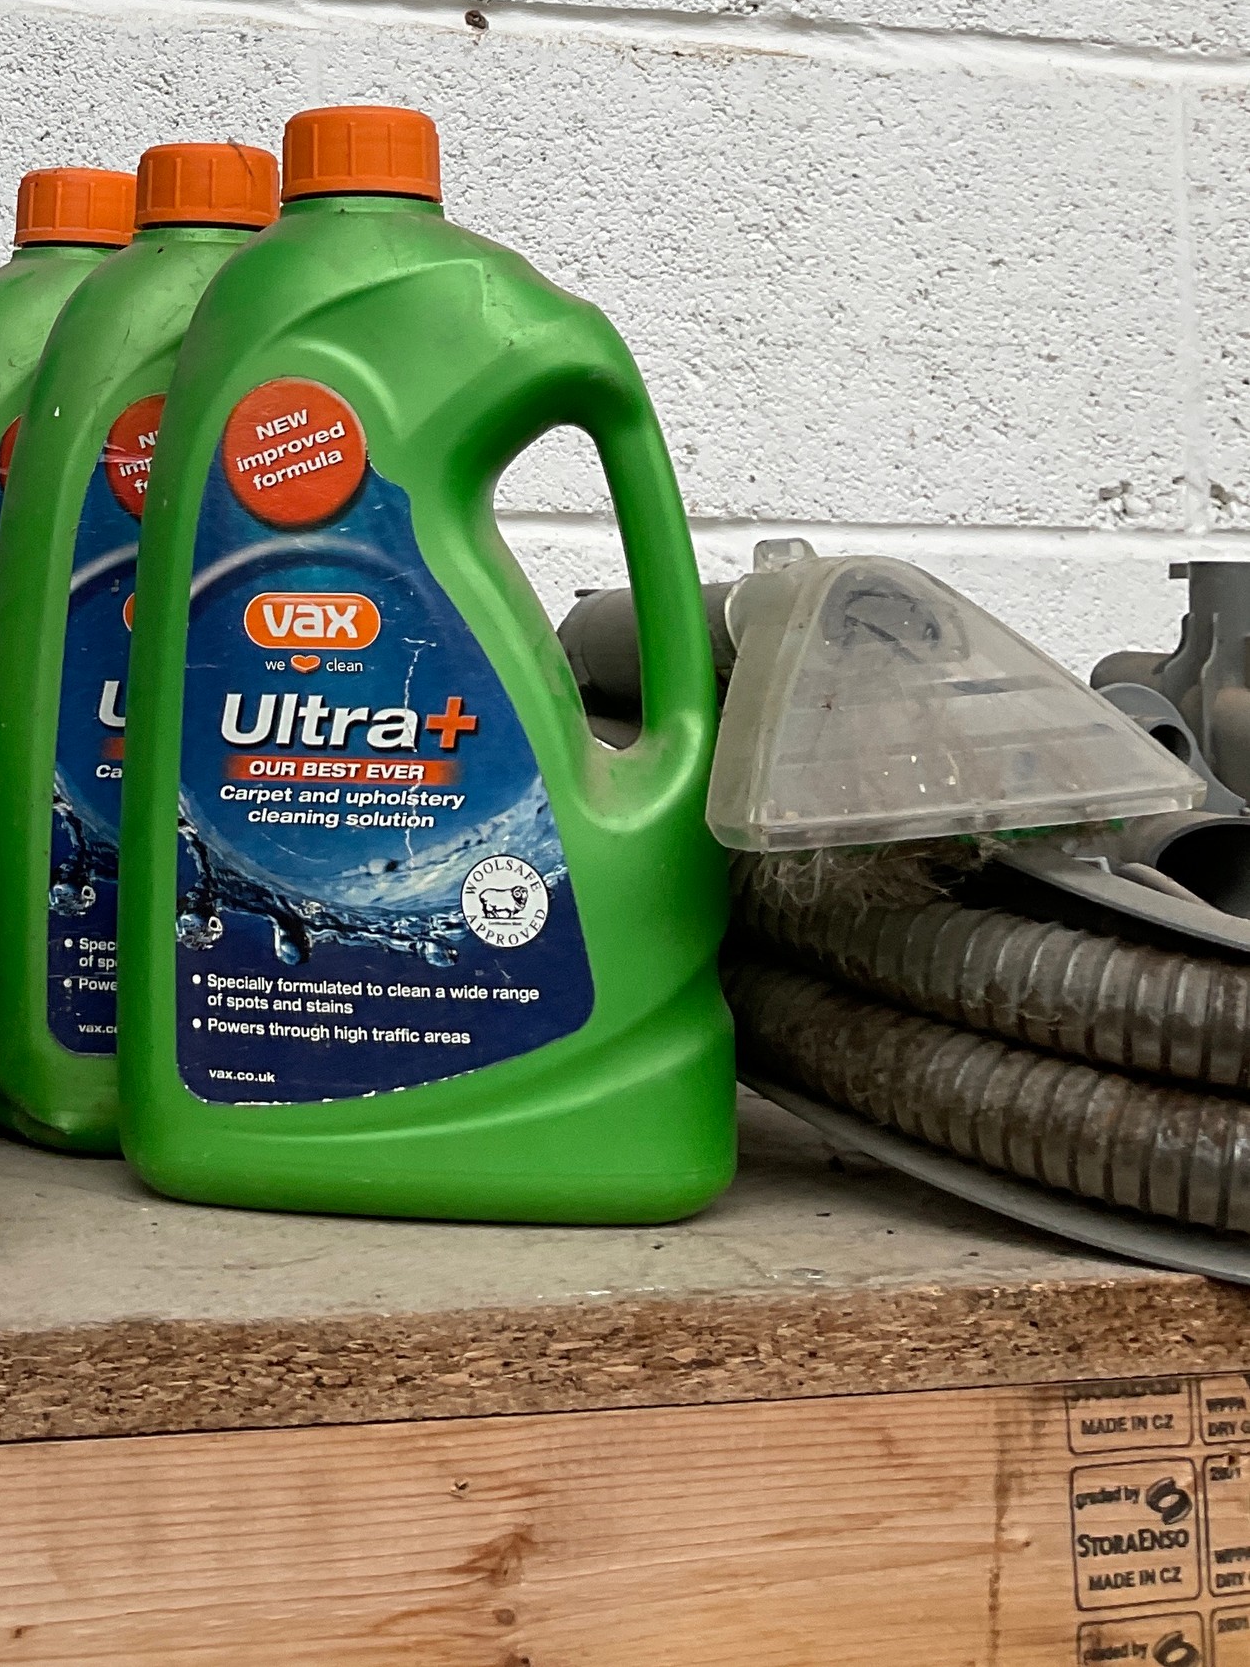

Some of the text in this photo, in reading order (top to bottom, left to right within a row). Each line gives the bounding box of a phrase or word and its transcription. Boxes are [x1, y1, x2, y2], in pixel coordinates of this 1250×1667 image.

[255, 409, 308, 441] NEW
[236, 421, 345, 472] improved
[253, 450, 343, 490] formula
[262, 604, 359, 638] vax
[265, 658, 363, 672] we clean
[249, 760, 425, 780] OUR BEST EVER
[220, 785, 465, 810] Carpet and upholstery
[248, 808, 435, 828] cleaning solution
[465, 859, 542, 894] WOOLSAFE
[466, 909, 546, 945] APPROVED
[79, 955, 94, 967] of
[207, 973, 540, 1003] Specially formulated to clean a wide range
[207, 993, 354, 1014] of spots and stains
[207, 1018, 471, 1044] Powers through high traffic areas
[208, 1069, 275, 1083] vax.co.uk
[1080, 1414, 1174, 1435] MADE IN CZ
[1089, 1566, 1182, 1591] MADE IN CZ
